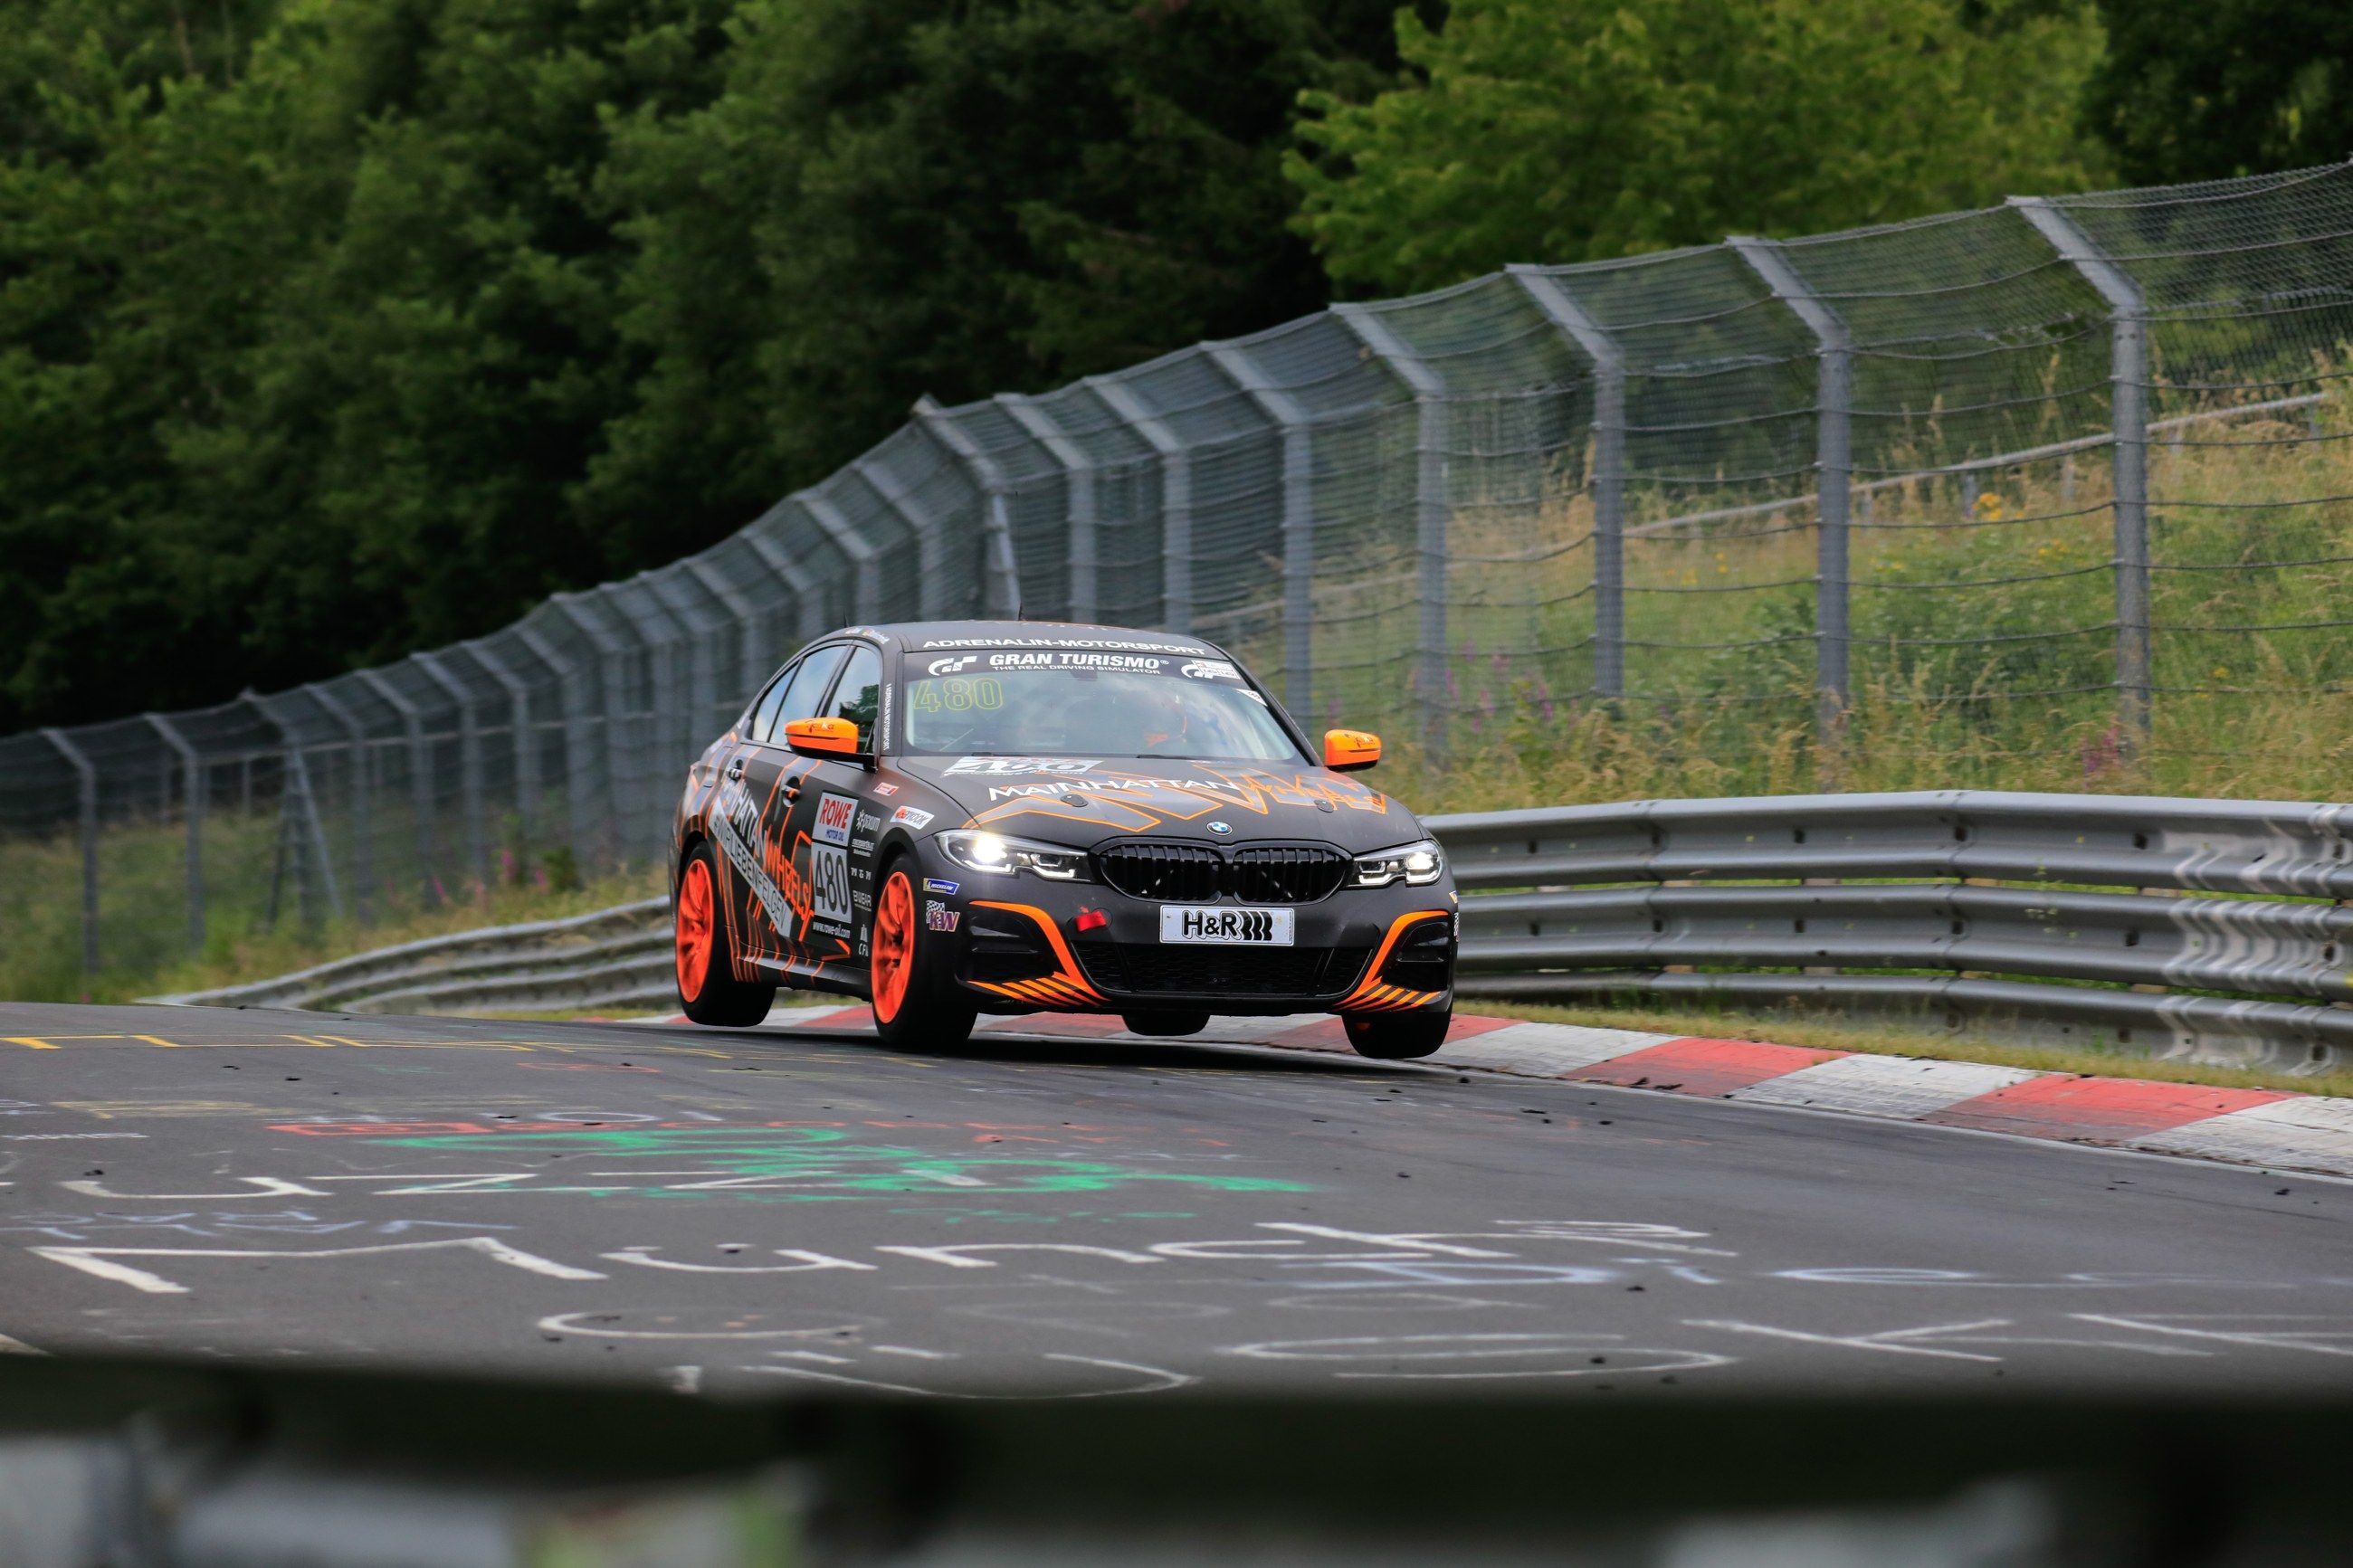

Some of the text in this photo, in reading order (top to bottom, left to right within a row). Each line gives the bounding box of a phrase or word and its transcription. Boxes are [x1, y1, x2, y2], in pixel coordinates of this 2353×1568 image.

[922, 638, 1206, 656] ADRENALIN-MOTORSPORT
[989, 653, 1053, 667] GRAN
[1098, 666, 1161, 675] SIMULATOR
[913, 678, 1005, 713] 480
[988, 779, 1240, 802] MAINHATTAN
[819, 798, 853, 830] ROWE
[815, 851, 849, 916] 480
[929, 911, 960, 933] KW
[1183, 911, 1239, 936] H&R
